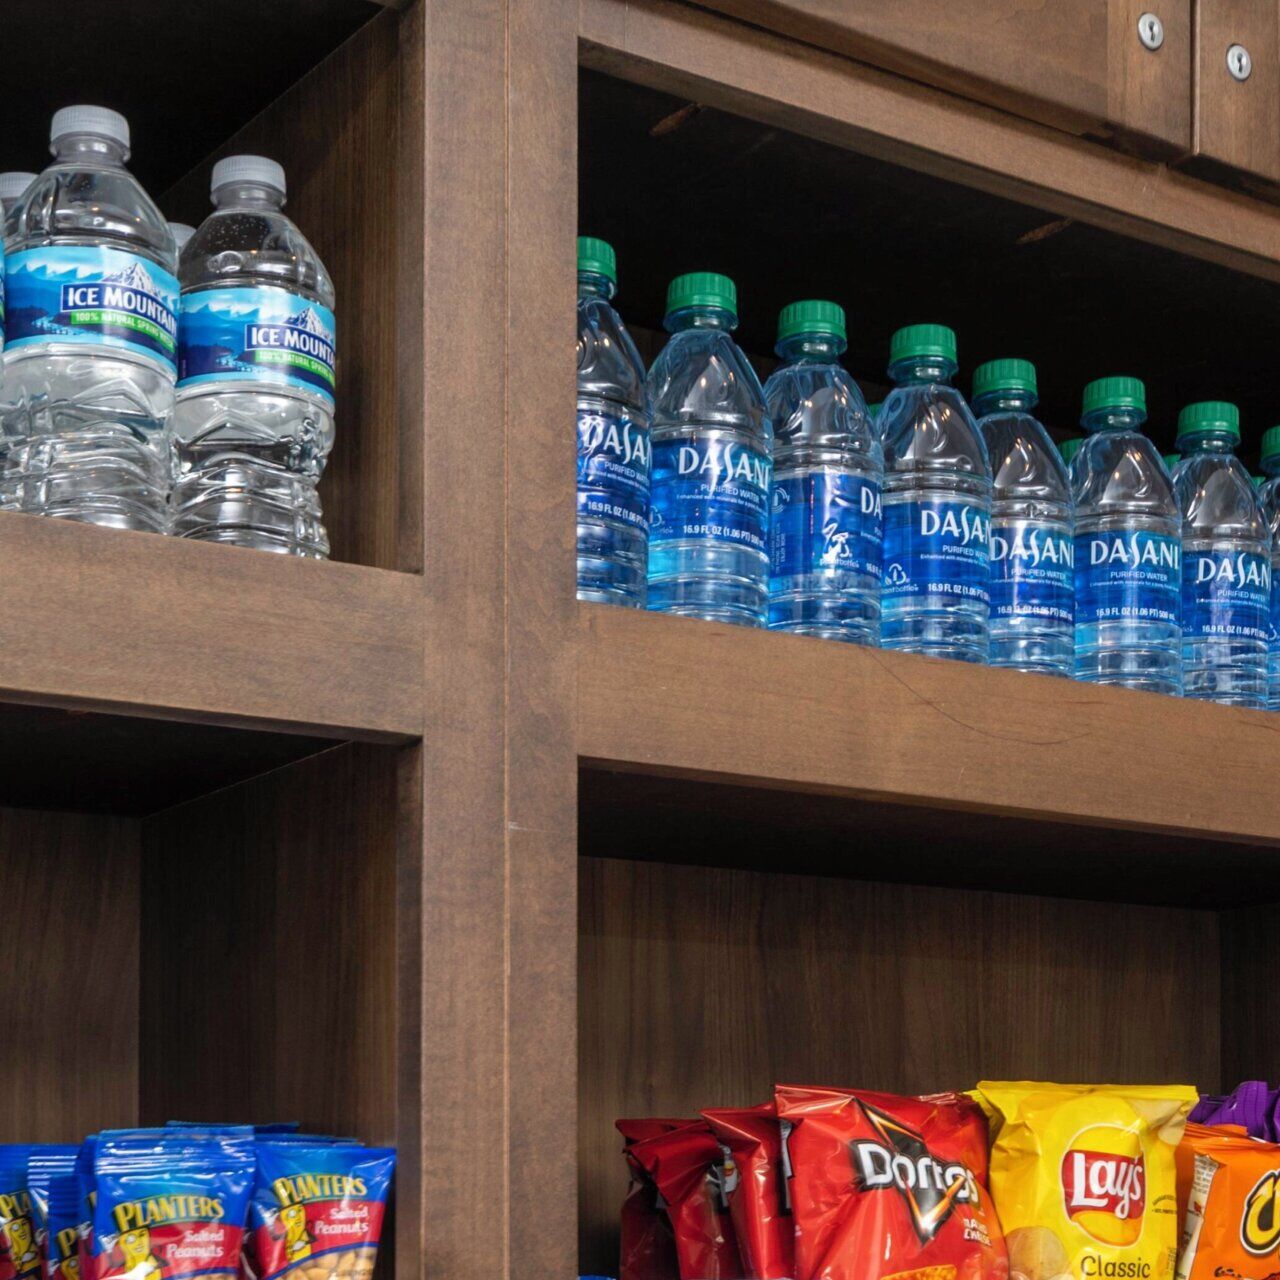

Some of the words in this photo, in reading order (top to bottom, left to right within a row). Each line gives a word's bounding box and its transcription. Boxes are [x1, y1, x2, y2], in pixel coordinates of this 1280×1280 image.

[68, 286, 100, 307] ICE
[75, 311, 98, 322] 100%
[100, 312, 135, 327] NATURAL
[251, 326, 280, 347] ICE
[604, 460, 636, 479] PURIFIED
[678, 442, 770, 493] DASANI
[700, 483, 739, 496] PURIFIED
[740, 488, 761, 504] WATER
[588, 501, 604, 513] 16.9
[604, 504, 612, 515] FL
[683, 524, 699, 535] 16.9
[701, 524, 710, 534] FL
[712, 525, 722, 536] OZ
[942, 544, 974, 557] PURIFIED
[988, 529, 1075, 570] DASANI
[1090, 532, 1179, 570] DASANI
[1110, 571, 1146, 579] PURIFIED
[1146, 572, 1168, 581] WATER
[928, 582, 944, 593] 16.9
[944, 583, 953, 593] FL
[953, 584, 962, 595] OZ
[1217, 588, 1250, 599] PURIFIED
[997, 605, 1012, 614] 16.9
[1096, 607, 1110, 617] 16.9
[1111, 607, 1120, 616] FL
[1121, 607, 1131, 616] OZ
[1202, 624, 1216, 634] 16.9
[1217, 624, 1225, 634] FL
[1226, 625, 1235, 635] OZ
[857, 1142, 980, 1204] Doritos
[275, 1174, 368, 1206] PLANTERS
[1071, 1152, 1144, 1219] Lay's
[114, 1194, 225, 1235] PLANTERS
[329, 1207, 369, 1221] Salted
[184, 1229, 225, 1245] Salted
[314, 1218, 369, 1237] Peanuts
[166, 1241, 225, 1261] Peanuts
[1080, 1255, 1152, 1279] Classic
